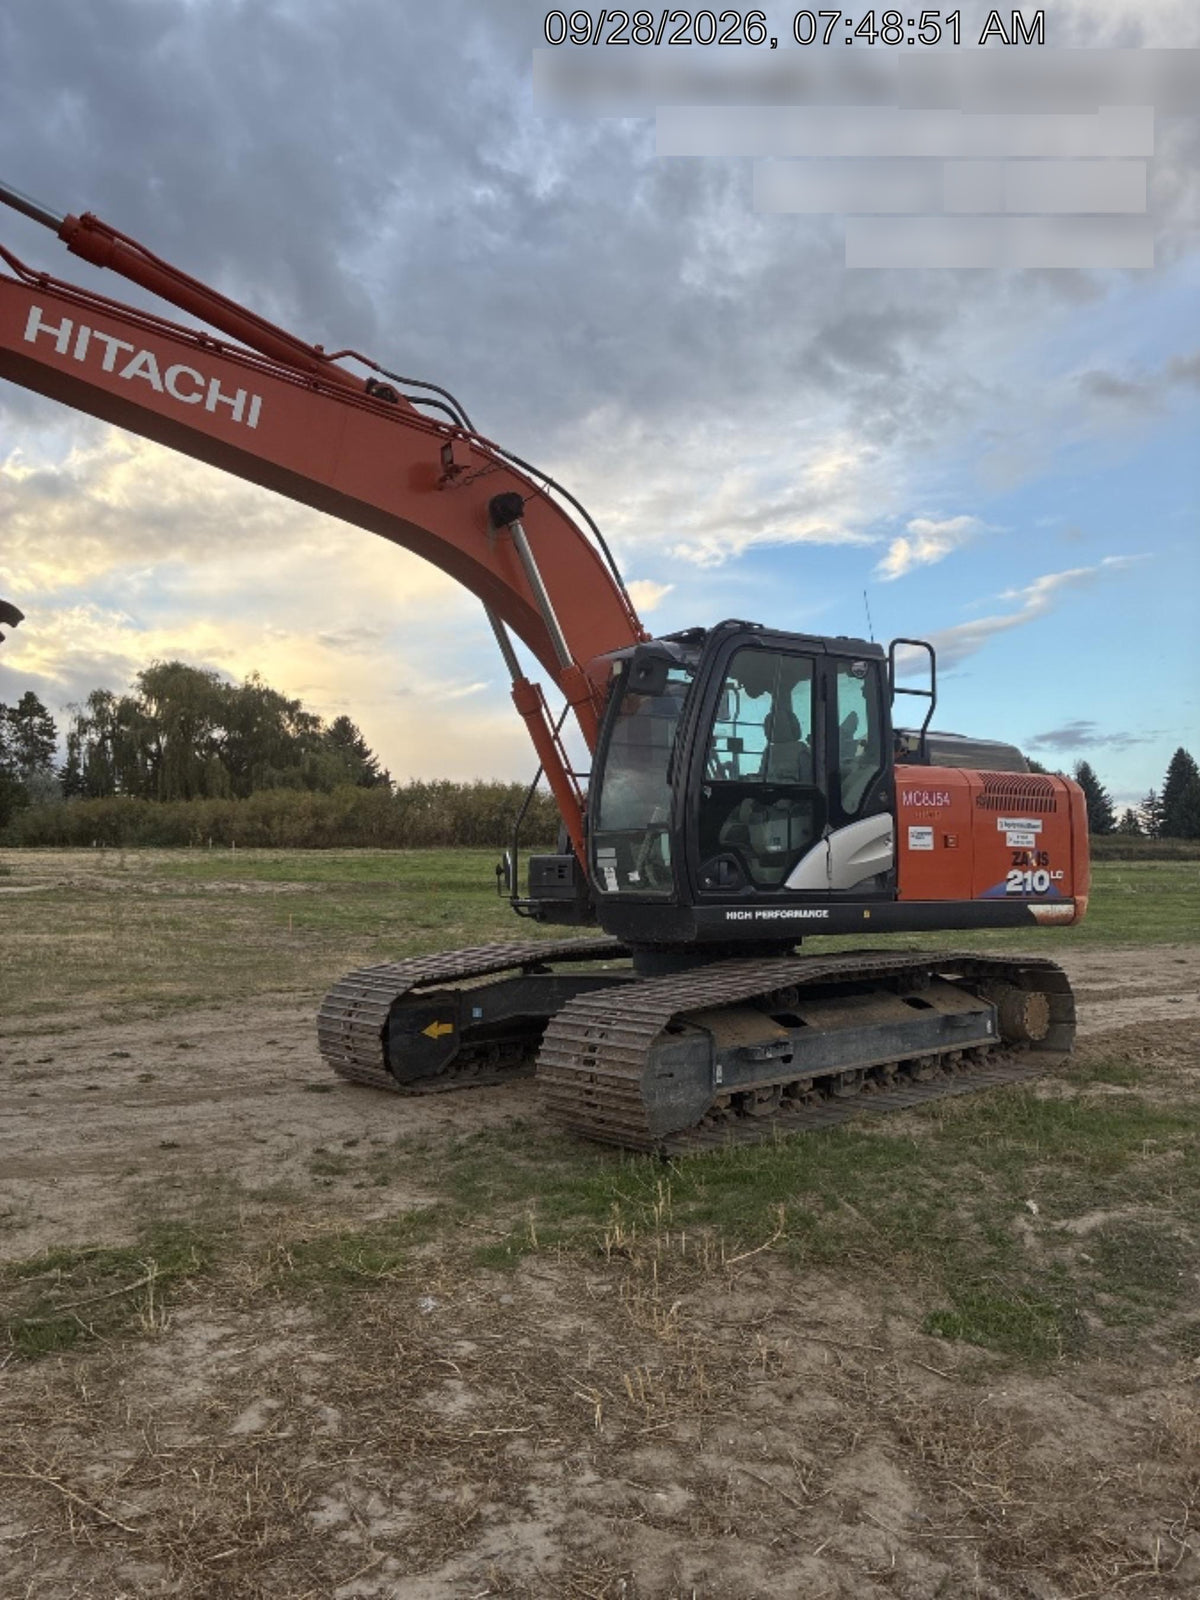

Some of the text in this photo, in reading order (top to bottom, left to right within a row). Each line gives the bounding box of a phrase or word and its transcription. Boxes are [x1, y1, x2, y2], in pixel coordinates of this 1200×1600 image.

[24, 305, 263, 429] HITACHI
[902, 790, 951, 807] MC8J54
[1005, 868, 1050, 894] 210
[726, 909, 830, 920] HIGH PERFORMANCE
